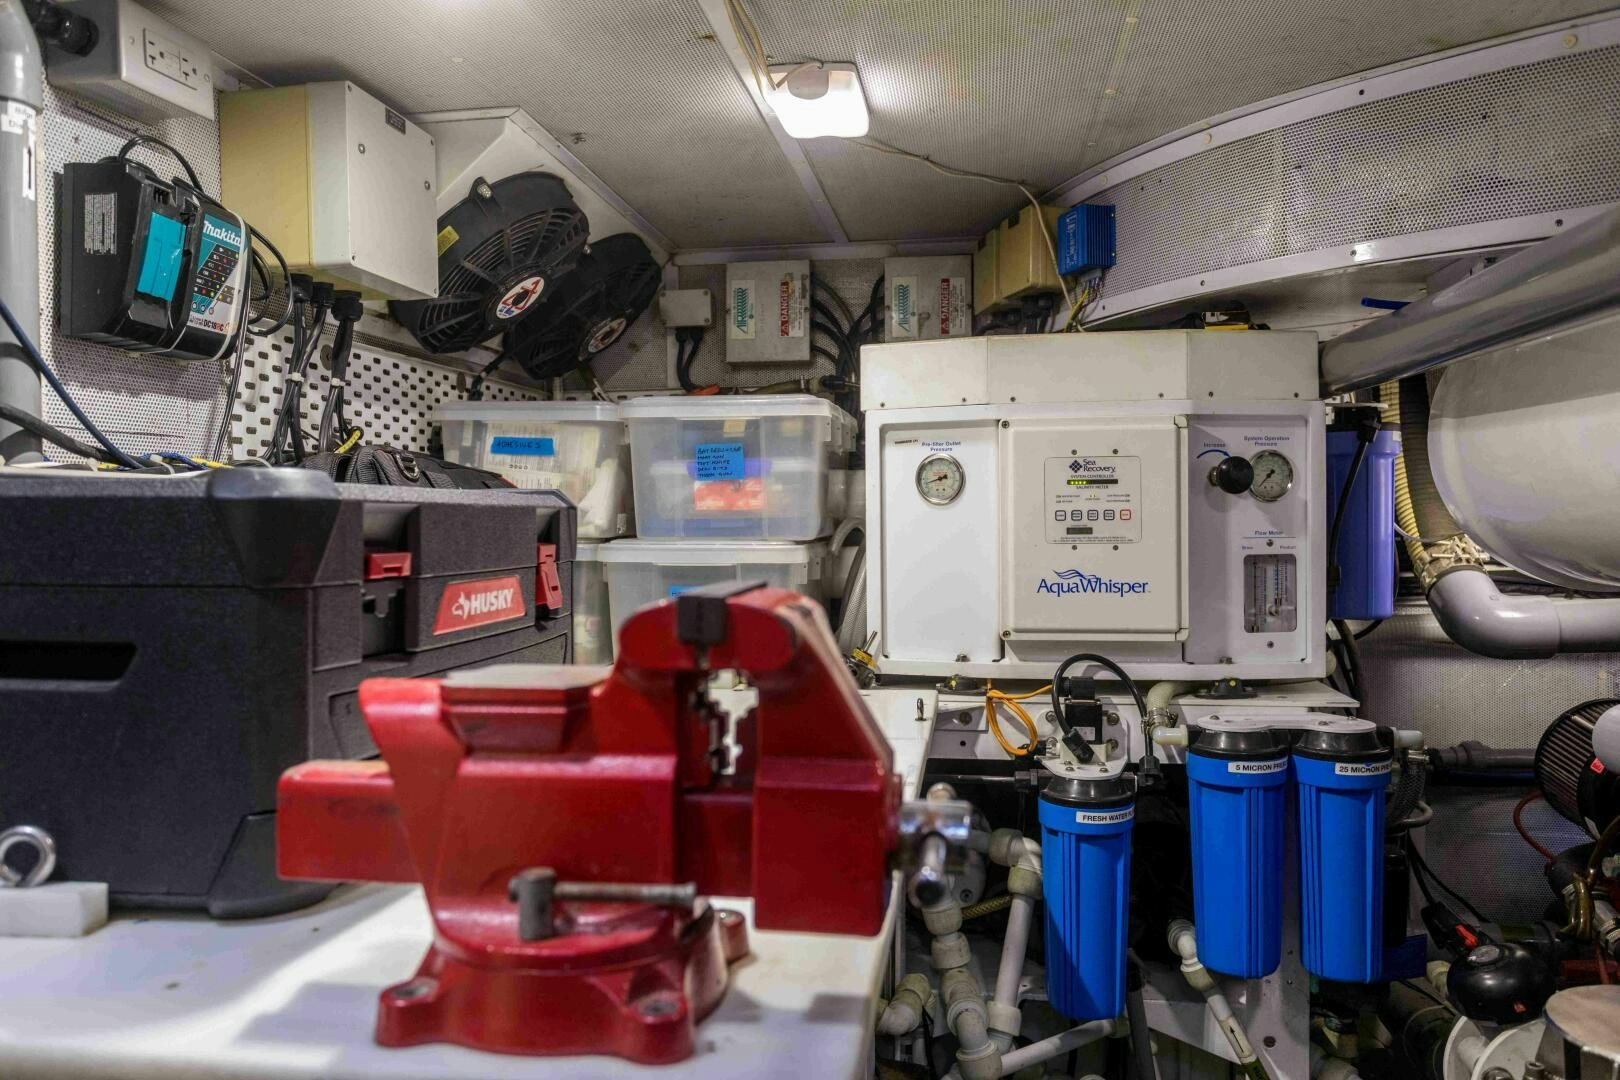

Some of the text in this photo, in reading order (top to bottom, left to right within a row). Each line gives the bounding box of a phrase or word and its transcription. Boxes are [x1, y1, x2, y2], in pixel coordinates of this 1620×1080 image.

[781, 285, 789, 320] DANGER
[941, 282, 949, 319] DANGER
[1083, 465, 1116, 473] Recovery
[1036, 577, 1149, 597] AquaWhisper
[470, 588, 514, 616] HUSKY
[1242, 764, 1272, 772] MICRON
[1339, 765, 1349, 773] 25
[1350, 765, 1380, 773] MICRON
[1082, 814, 1107, 822] FRESH
[1108, 812, 1128, 821] WATER
